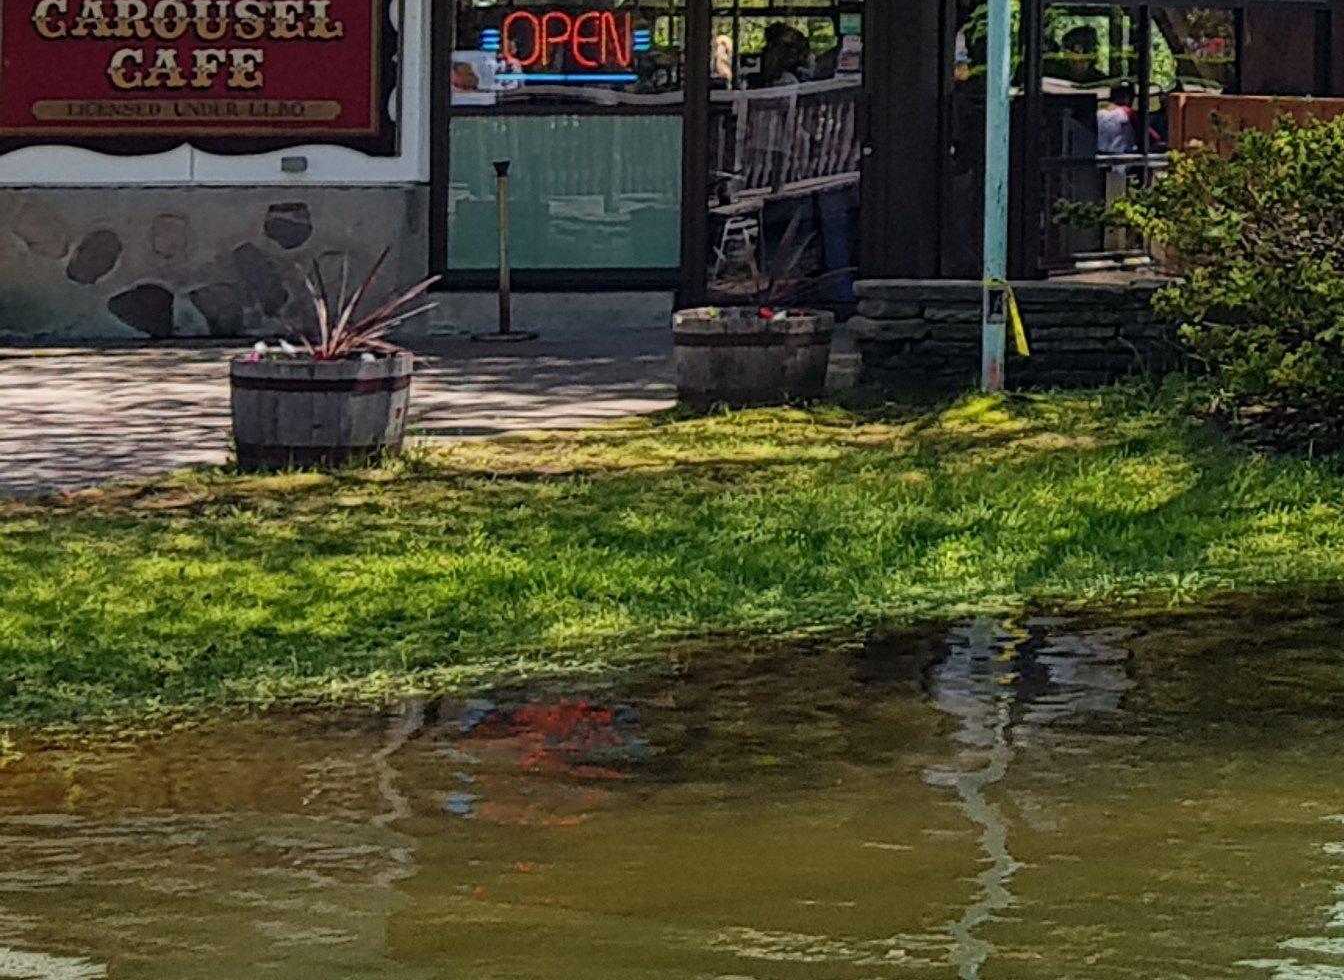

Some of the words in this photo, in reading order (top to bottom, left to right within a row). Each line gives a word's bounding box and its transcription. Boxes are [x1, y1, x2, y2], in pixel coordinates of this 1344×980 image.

[502, 10, 632, 67] OPEN
[108, 48, 264, 88] CAFE
[173, 101, 239, 117] UNDER
